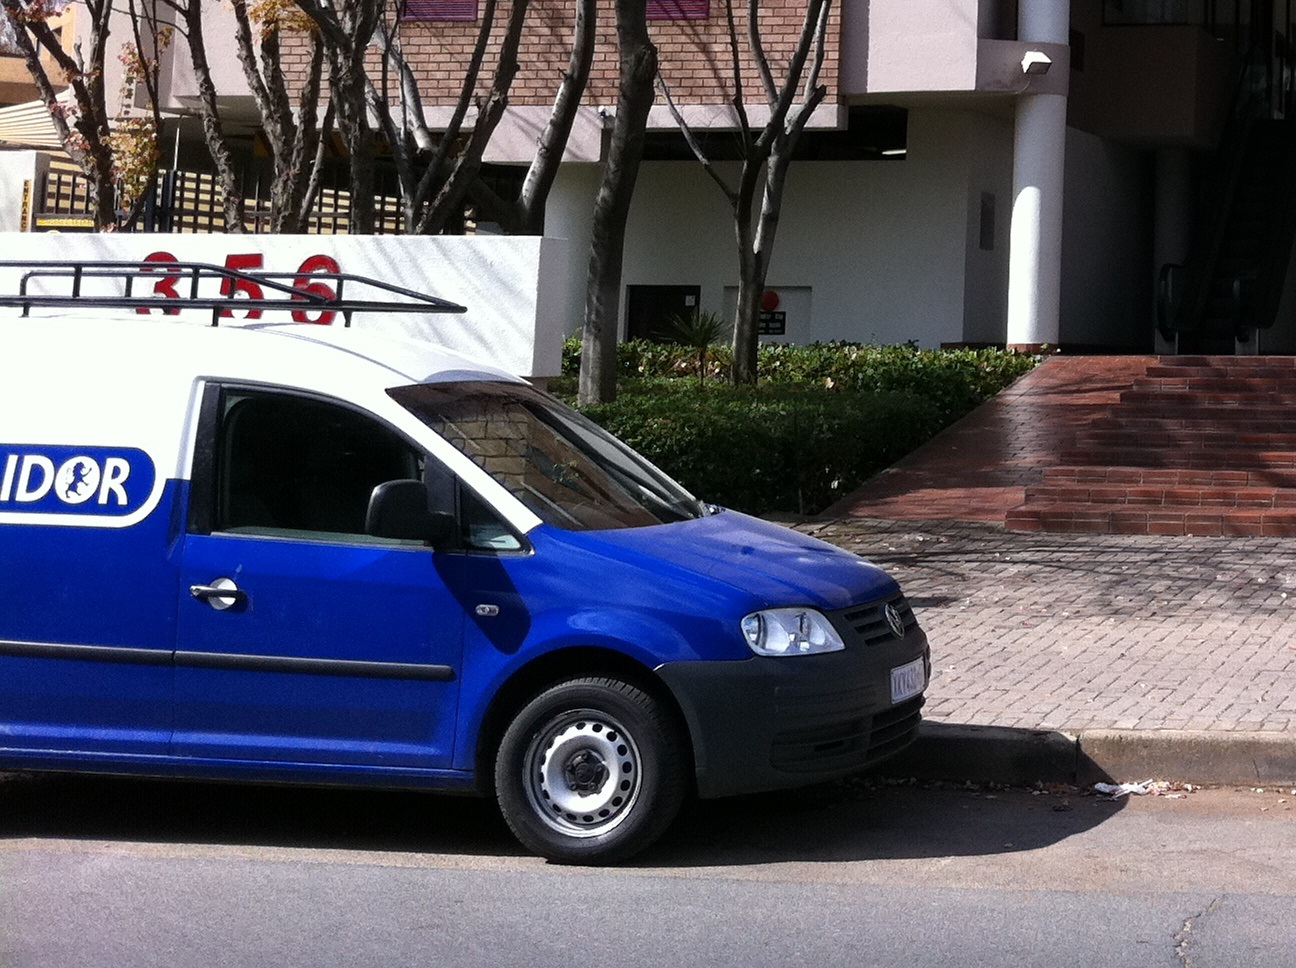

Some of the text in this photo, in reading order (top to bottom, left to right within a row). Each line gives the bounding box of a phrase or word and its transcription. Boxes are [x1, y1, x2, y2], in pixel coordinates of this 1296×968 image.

[20, 180, 29, 232] ENTRANC
[136, 251, 340, 325] 356
[0, 454, 130, 506] IDOR
